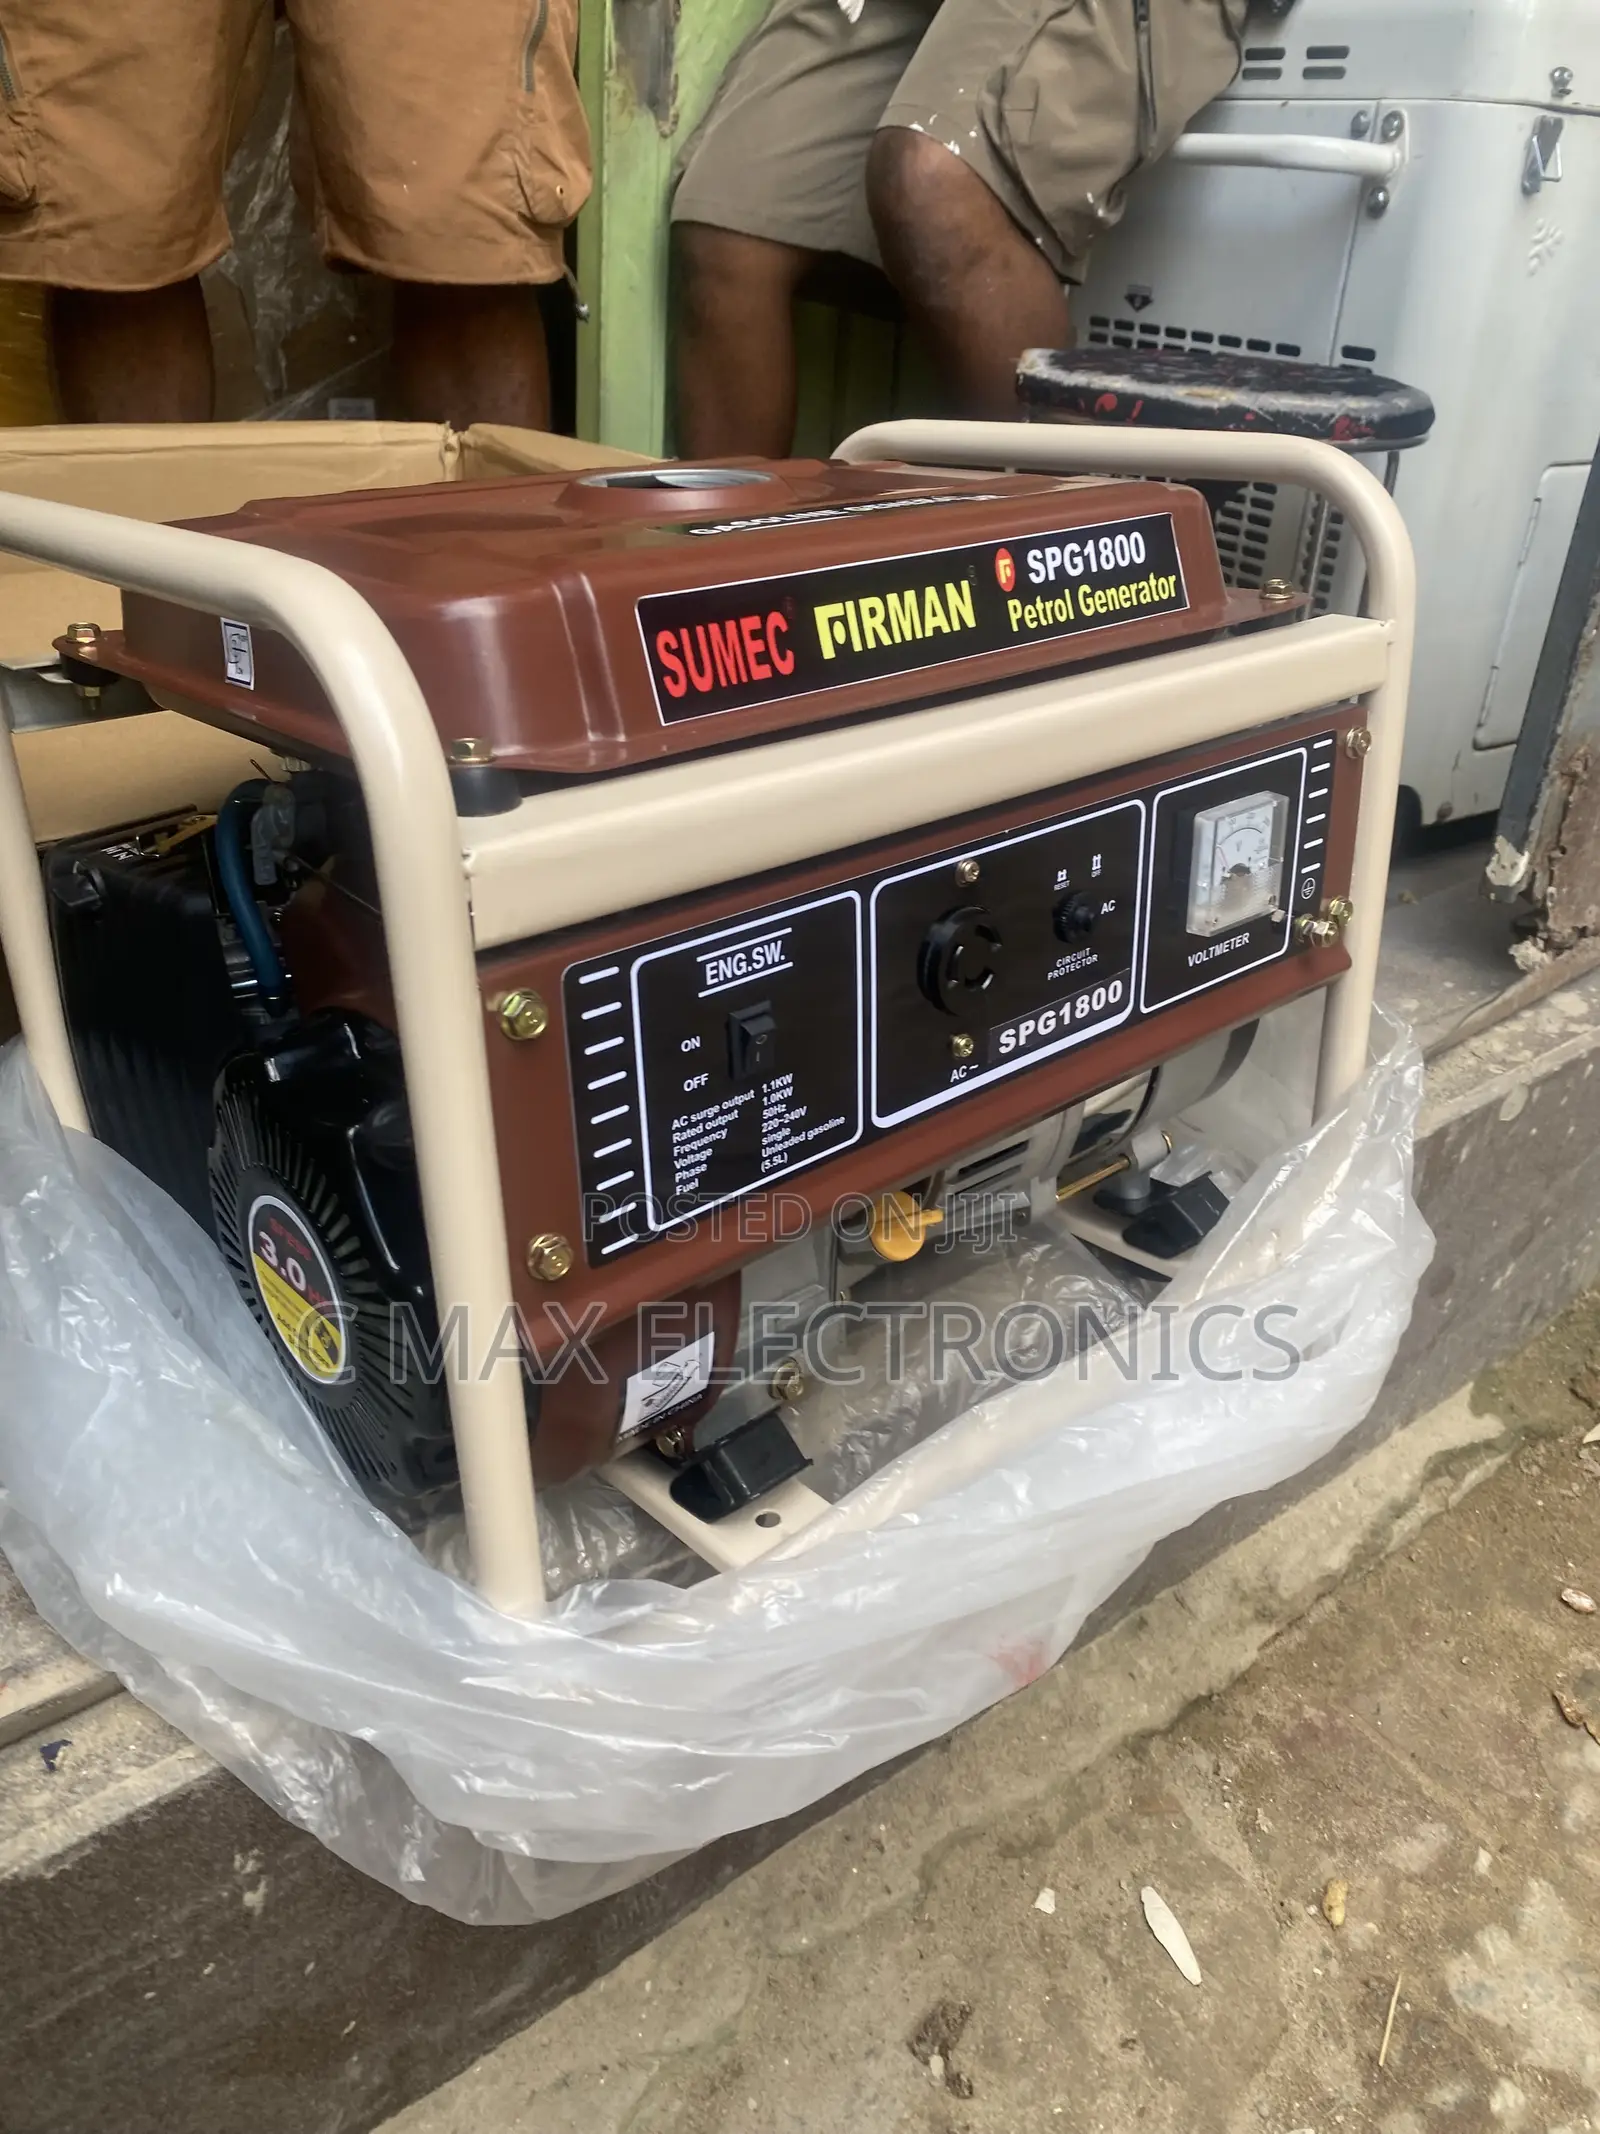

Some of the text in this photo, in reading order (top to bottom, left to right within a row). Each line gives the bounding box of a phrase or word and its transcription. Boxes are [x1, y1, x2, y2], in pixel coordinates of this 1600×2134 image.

[689, 507, 848, 536] GASOLINE
[1026, 531, 1146, 584] SPG1800
[1007, 572, 1177, 632] Petrol Generator
[655, 579, 977, 698] SUMEC FIRMAN
[1053, 880, 1071, 891] RESET
[1101, 900, 1116, 915] AC
[705, 940, 785, 986] ENG.SW.
[1047, 954, 1098, 980] PROTECTOR
[1056, 947, 1091, 968] CIRCUIT
[1187, 932, 1250, 967] VOLTMETER
[998, 979, 1123, 1054] SPG1800
[680, 1036, 701, 1052] ON
[672, 1073, 794, 1130] AC surge output 1.1KW
[683, 1072, 709, 1092] OFF
[672, 1086, 794, 1143] Rated output 1.0KW
[673, 1103, 787, 1157] Frequency 50Hz
[674, 1126, 791, 1183] Phase single
[674, 1148, 713, 1169] Voltage
[675, 1115, 846, 1196] Fuel Unleaded gasoline
[760, 1152, 788, 1173] (5.5L)
[259, 1230, 306, 1292] 3.0
